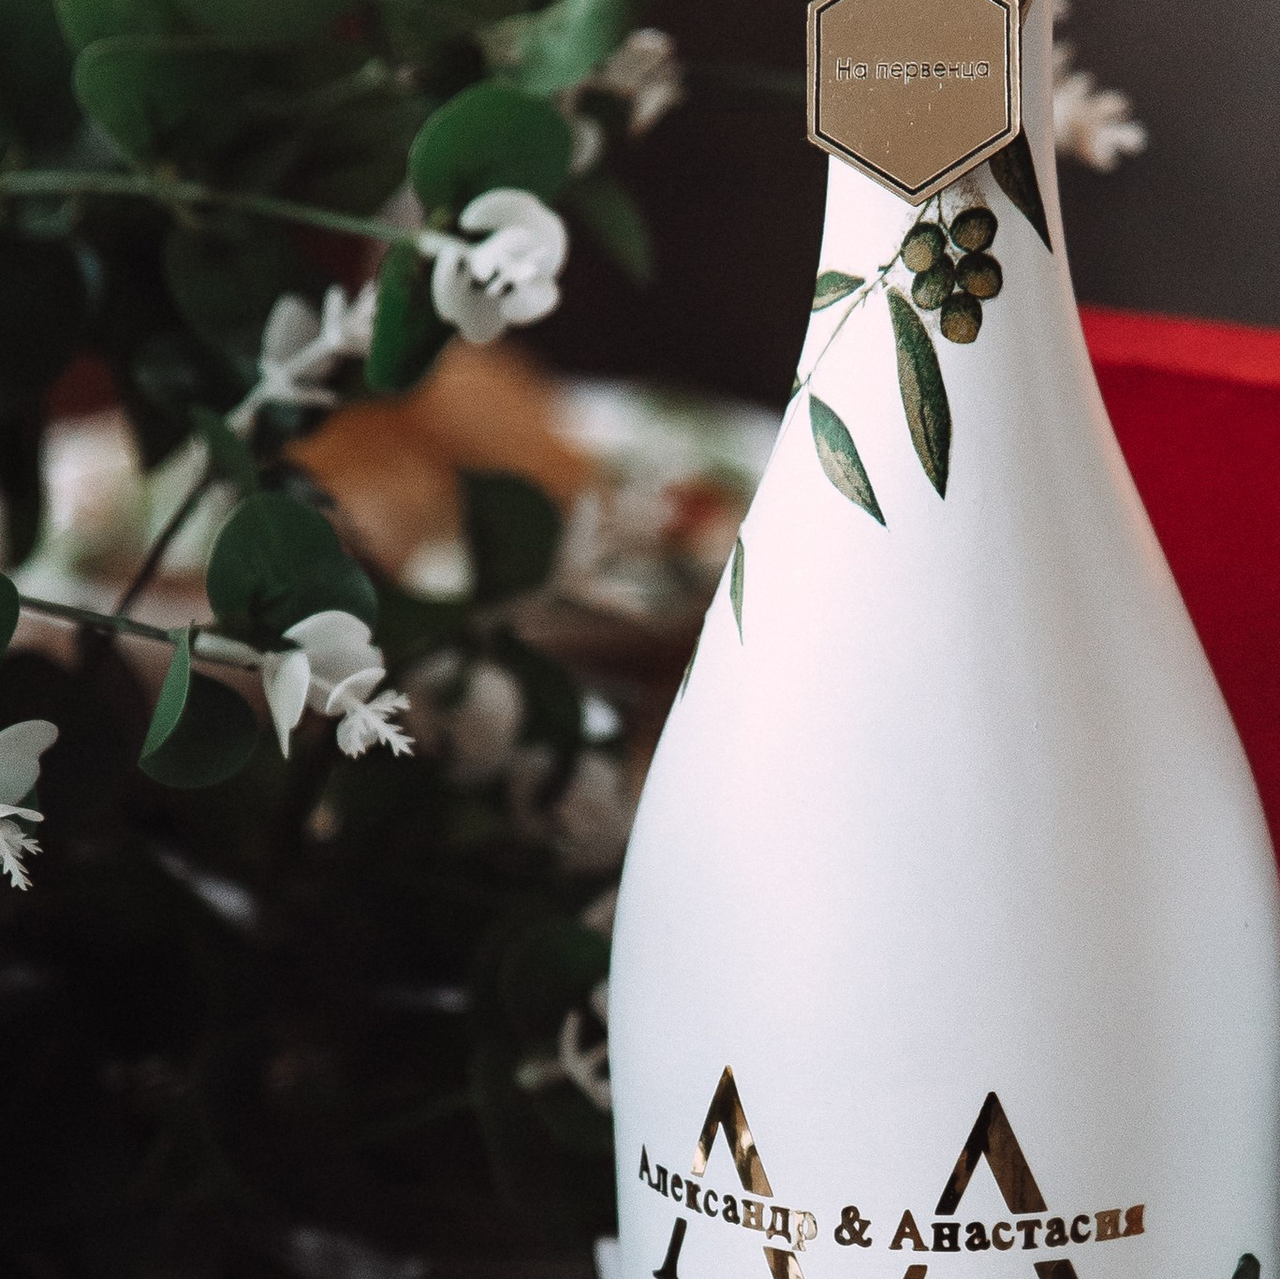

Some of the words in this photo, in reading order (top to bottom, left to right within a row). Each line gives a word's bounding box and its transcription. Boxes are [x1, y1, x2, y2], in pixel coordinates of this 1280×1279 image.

[836, 58, 868, 80] На
[876, 60, 990, 85] первенца
[639, 1143, 818, 1251] Александр
[833, 1205, 872, 1248] &
[889, 1203, 1146, 1252] Анастасия
